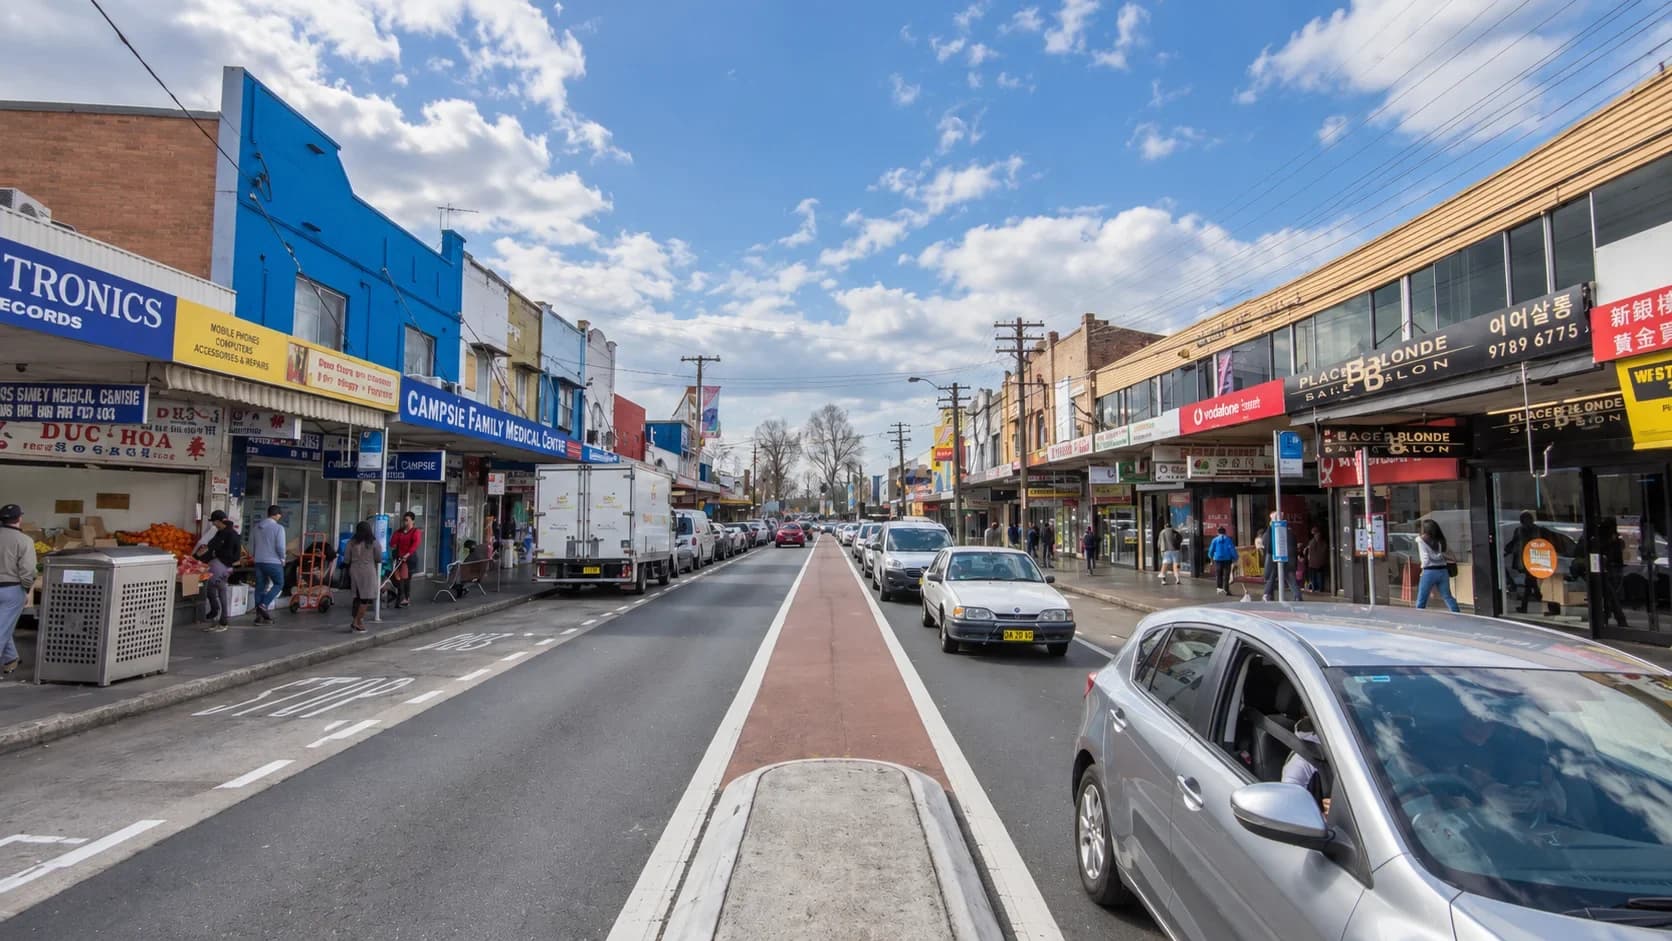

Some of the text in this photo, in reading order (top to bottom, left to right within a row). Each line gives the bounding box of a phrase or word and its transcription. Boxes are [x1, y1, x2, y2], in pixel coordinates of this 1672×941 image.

[4, 253, 163, 329] TRONICS
[1488, 322, 1578, 359] 9789 6775
[40, 422, 101, 443] DUC
[119, 428, 173, 449] HOA
[407, 390, 466, 428] CAMPSIE
[468, 406, 504, 438] FAMILY
[506, 419, 541, 448] MEDICAL
